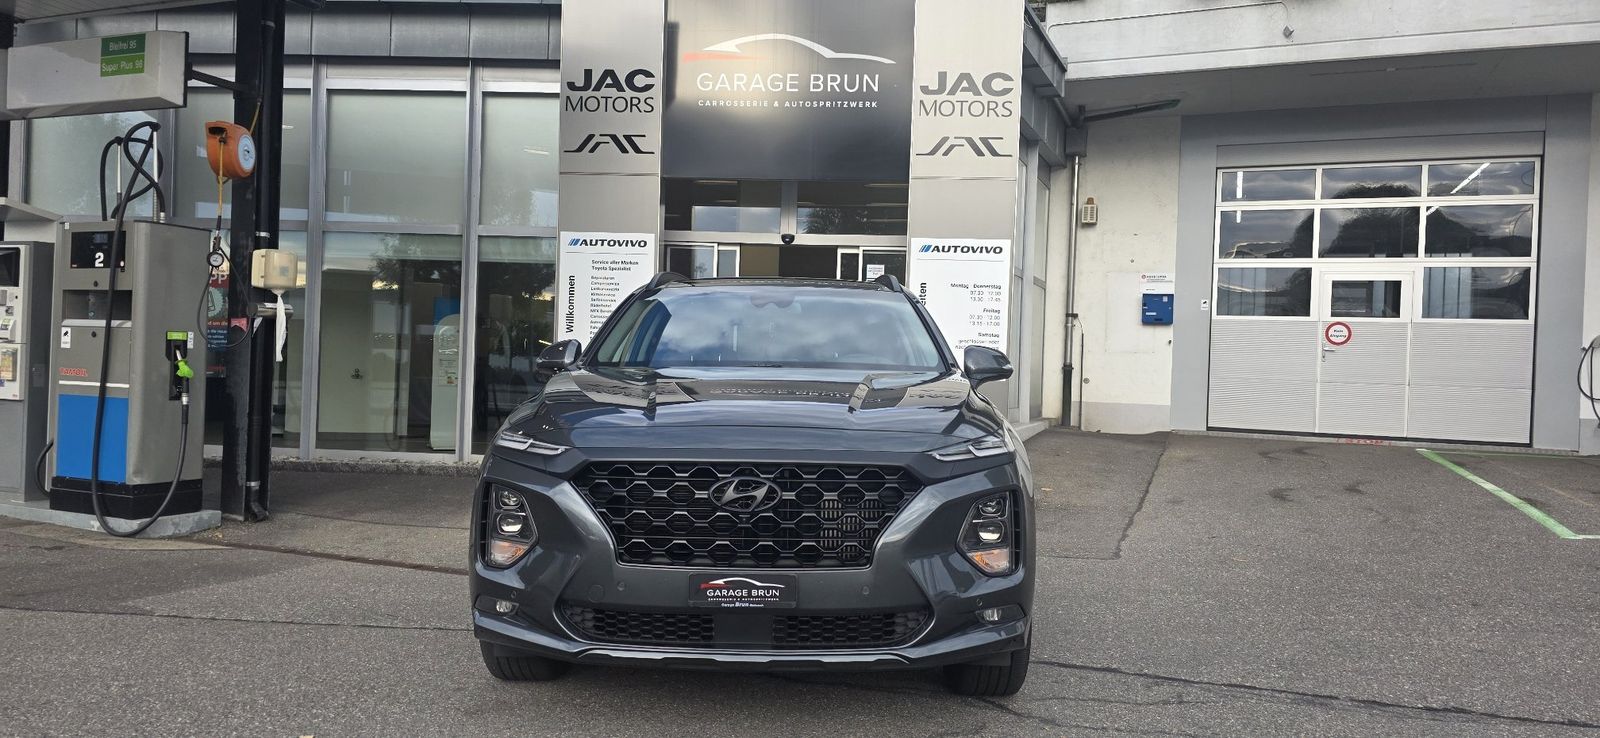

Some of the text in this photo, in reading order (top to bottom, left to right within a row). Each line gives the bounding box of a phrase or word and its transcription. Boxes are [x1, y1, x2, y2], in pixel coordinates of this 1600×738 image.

[129, 40, 137, 49] 95
[102, 63, 119, 72] Super
[120, 61, 133, 70] Plus
[567, 68, 655, 92] JAC
[696, 72, 879, 93] GARAGE BRUN
[920, 71, 1014, 96] JAC
[565, 95, 654, 113] MOTORS
[698, 99, 878, 109] CARROSSERIE & AUTOSPRITZWERK
[919, 99, 1012, 117] MOTORS
[580, 239, 647, 248] AUTOVIVO
[931, 245, 1003, 254] AUTOVIVO
[94, 252, 104, 267] 2
[565, 275, 576, 334] Willkommen
